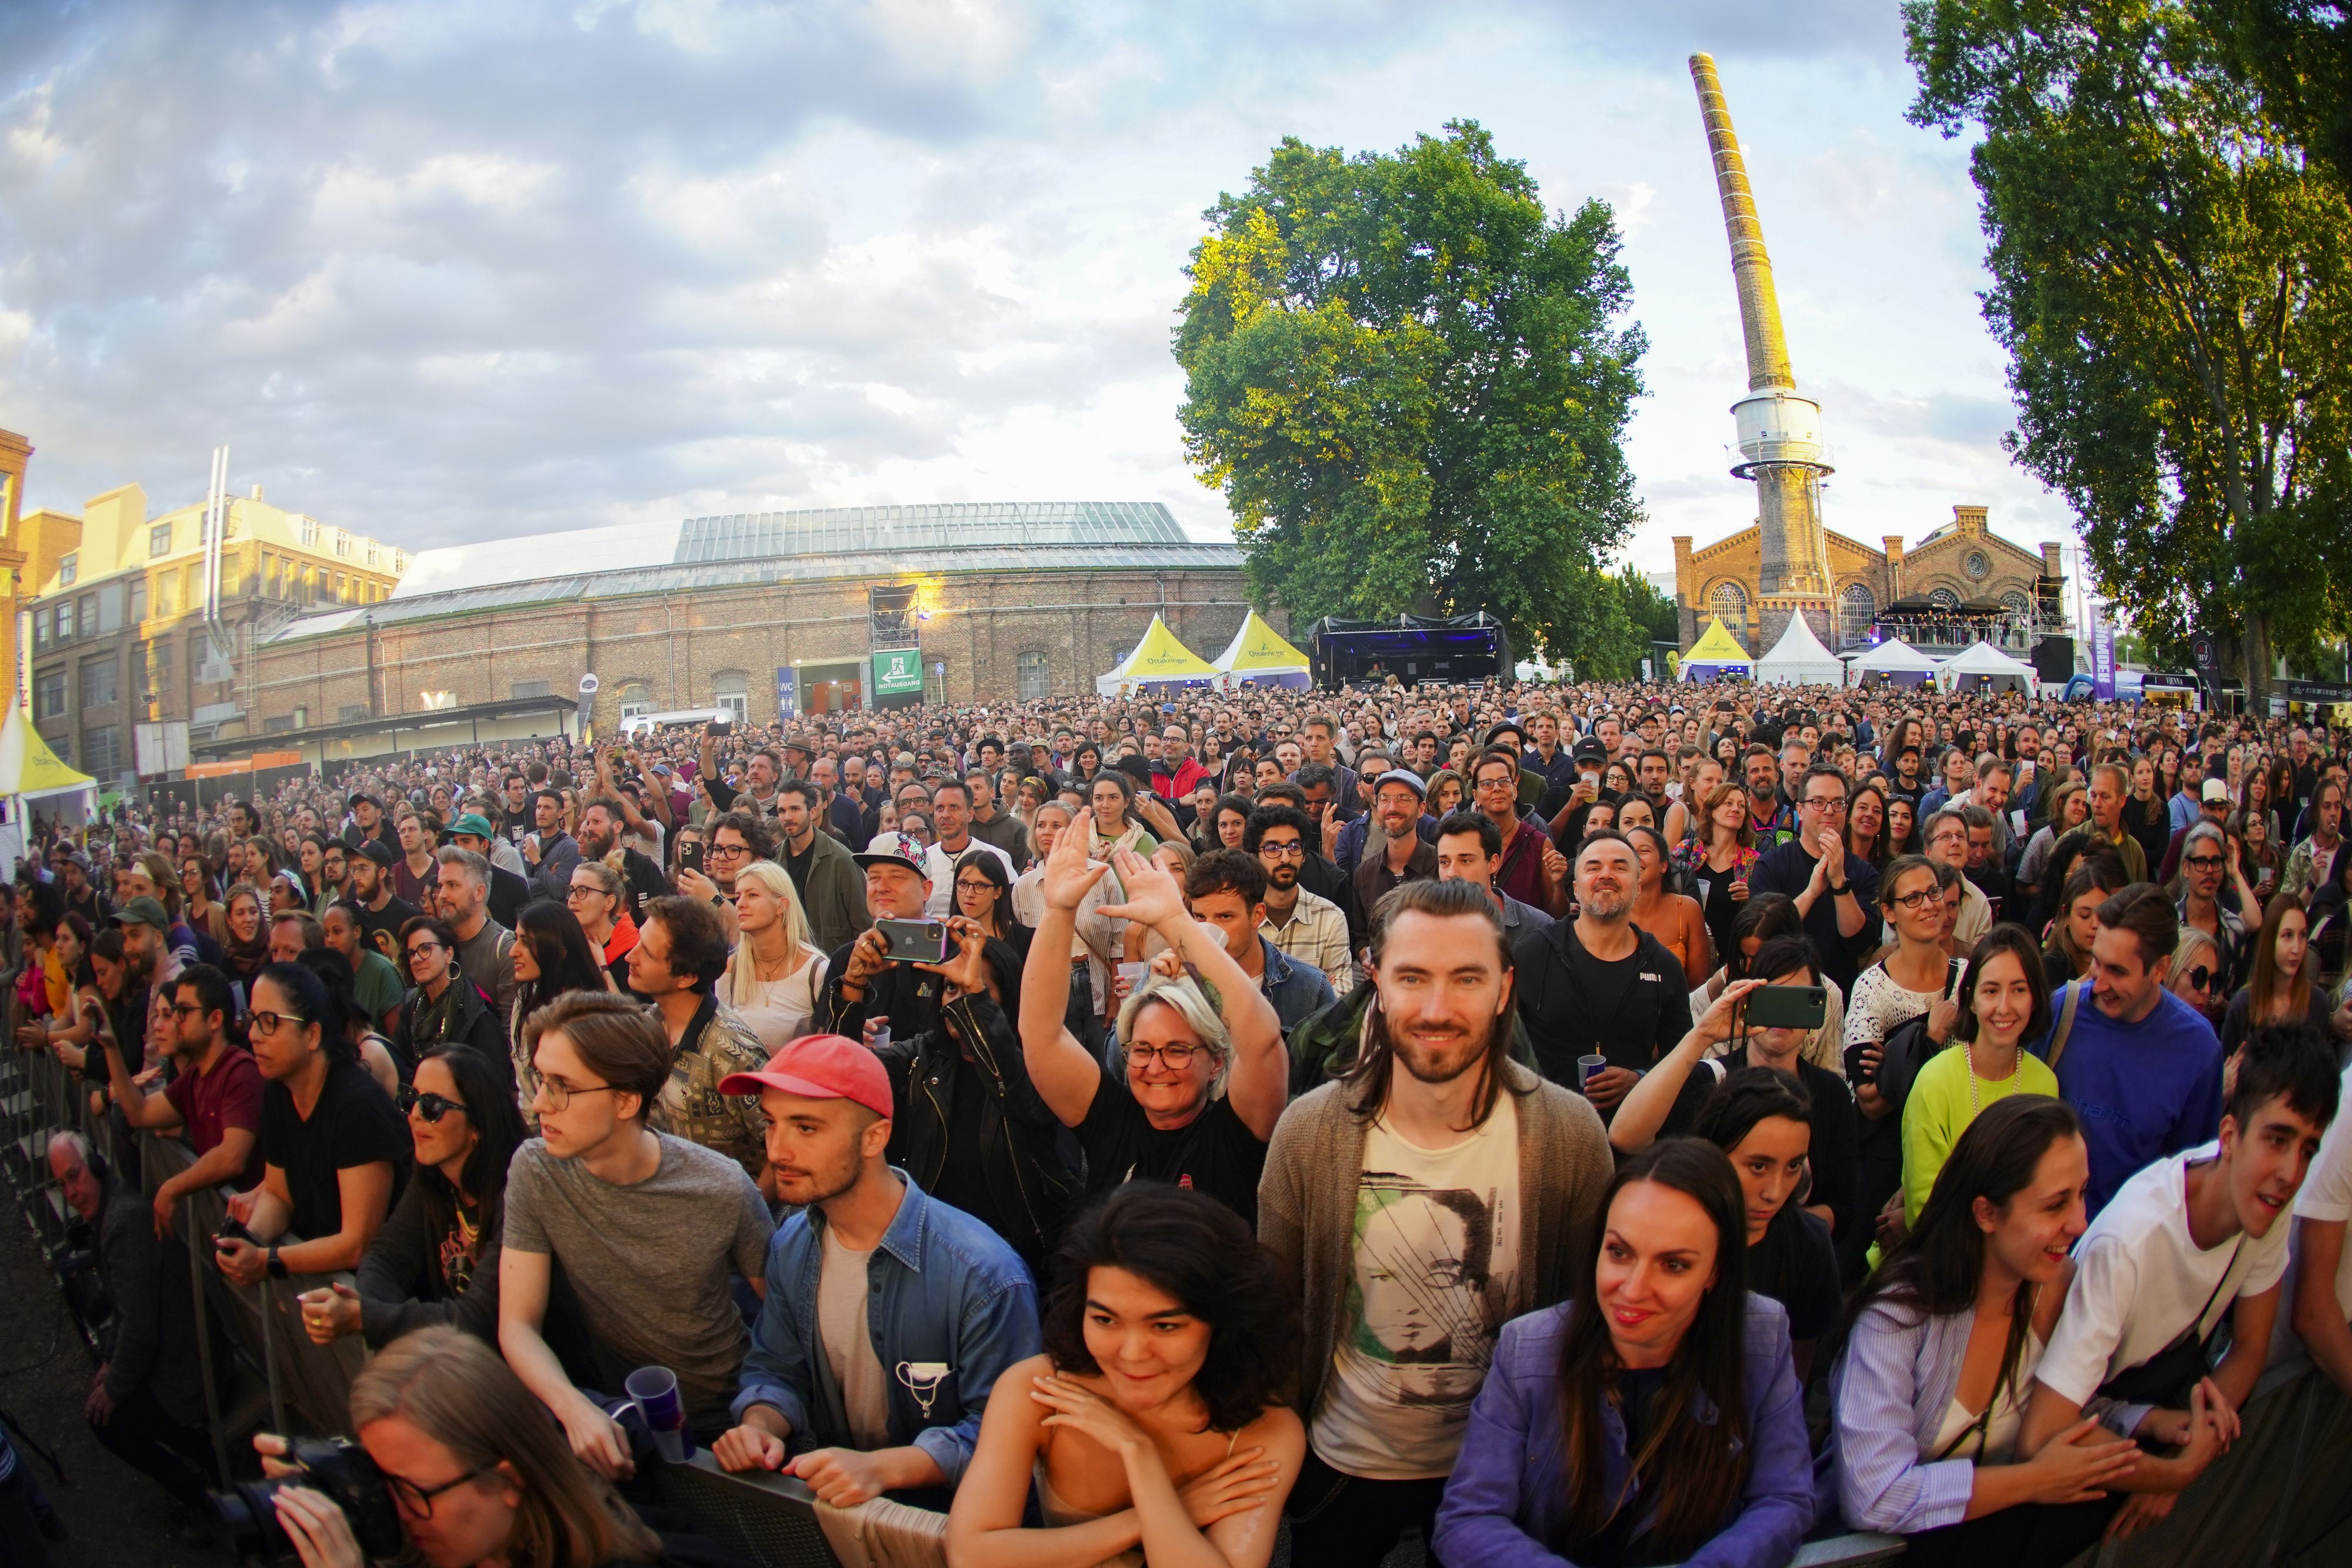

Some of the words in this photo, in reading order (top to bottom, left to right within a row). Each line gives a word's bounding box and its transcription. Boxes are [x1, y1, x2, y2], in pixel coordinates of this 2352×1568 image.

[878, 680, 920, 689] NOTAUSGANG
[2166, 677, 2183, 686] VIENNA
[780, 682, 793, 692] WC
